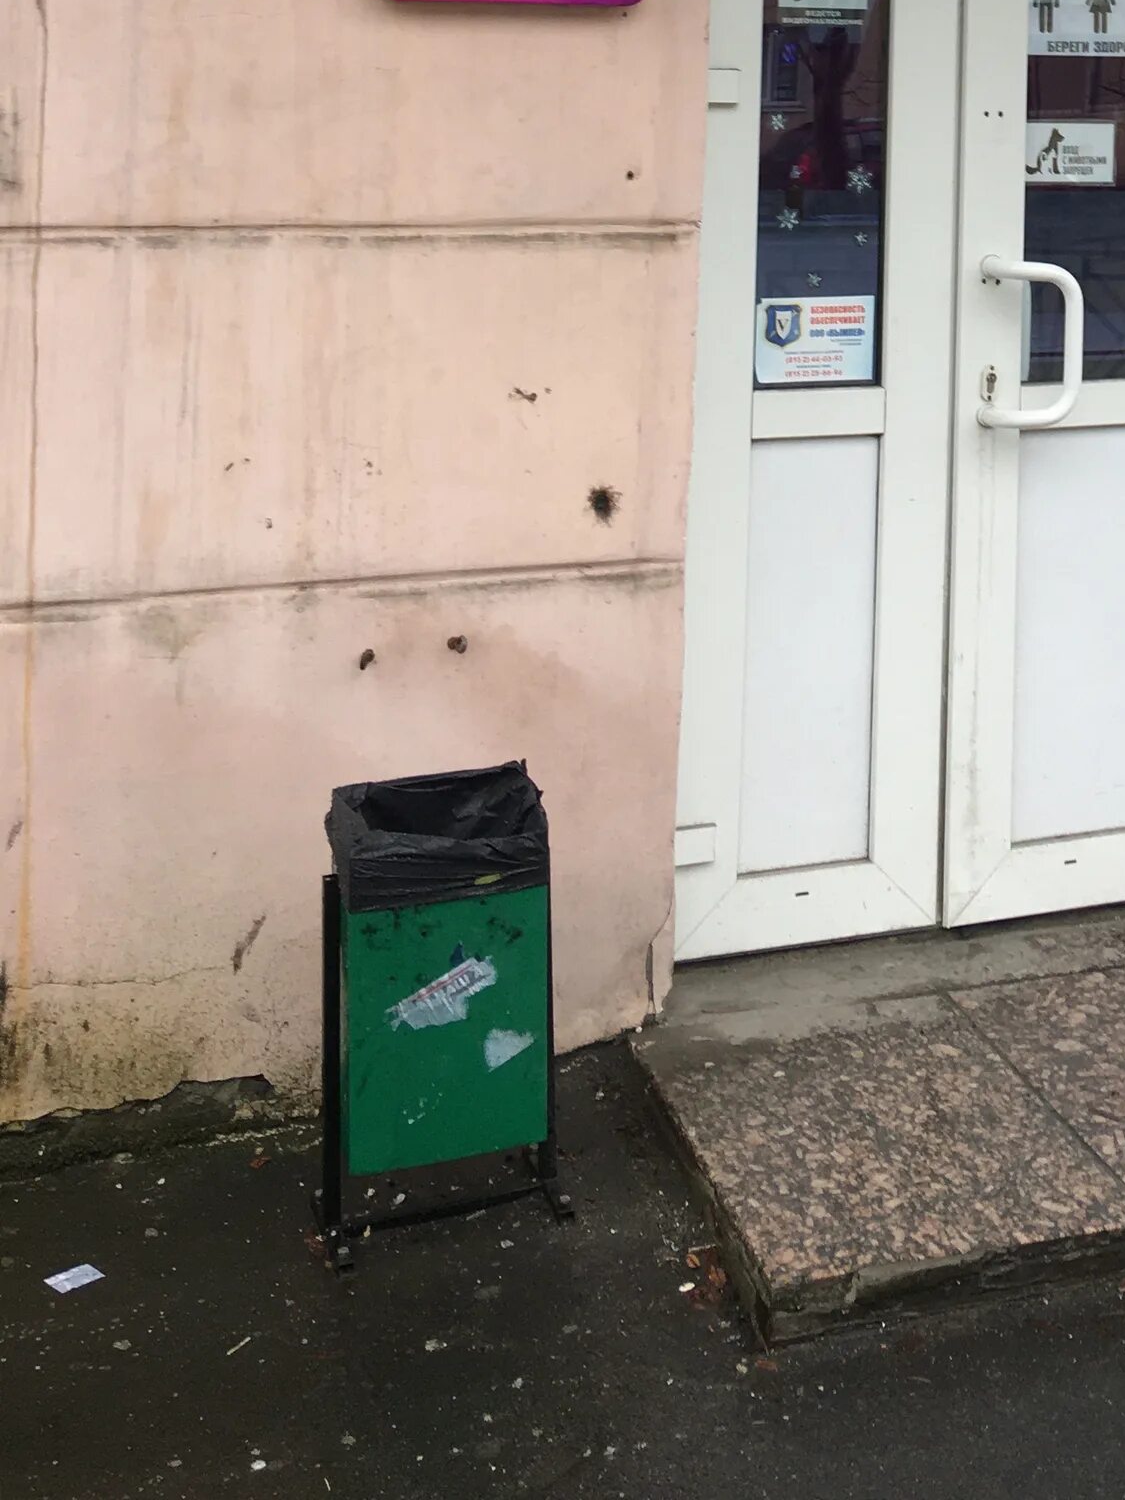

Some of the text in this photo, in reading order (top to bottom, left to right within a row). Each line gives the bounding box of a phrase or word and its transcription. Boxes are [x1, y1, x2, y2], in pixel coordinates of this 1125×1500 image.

[1047, 40, 1090, 53] БЕРЕГИ
[810, 305, 866, 315] БЕЗОПАСНОСТЬ
[810, 316, 866, 325] ОБЕСПЕЧИВАЕТ
